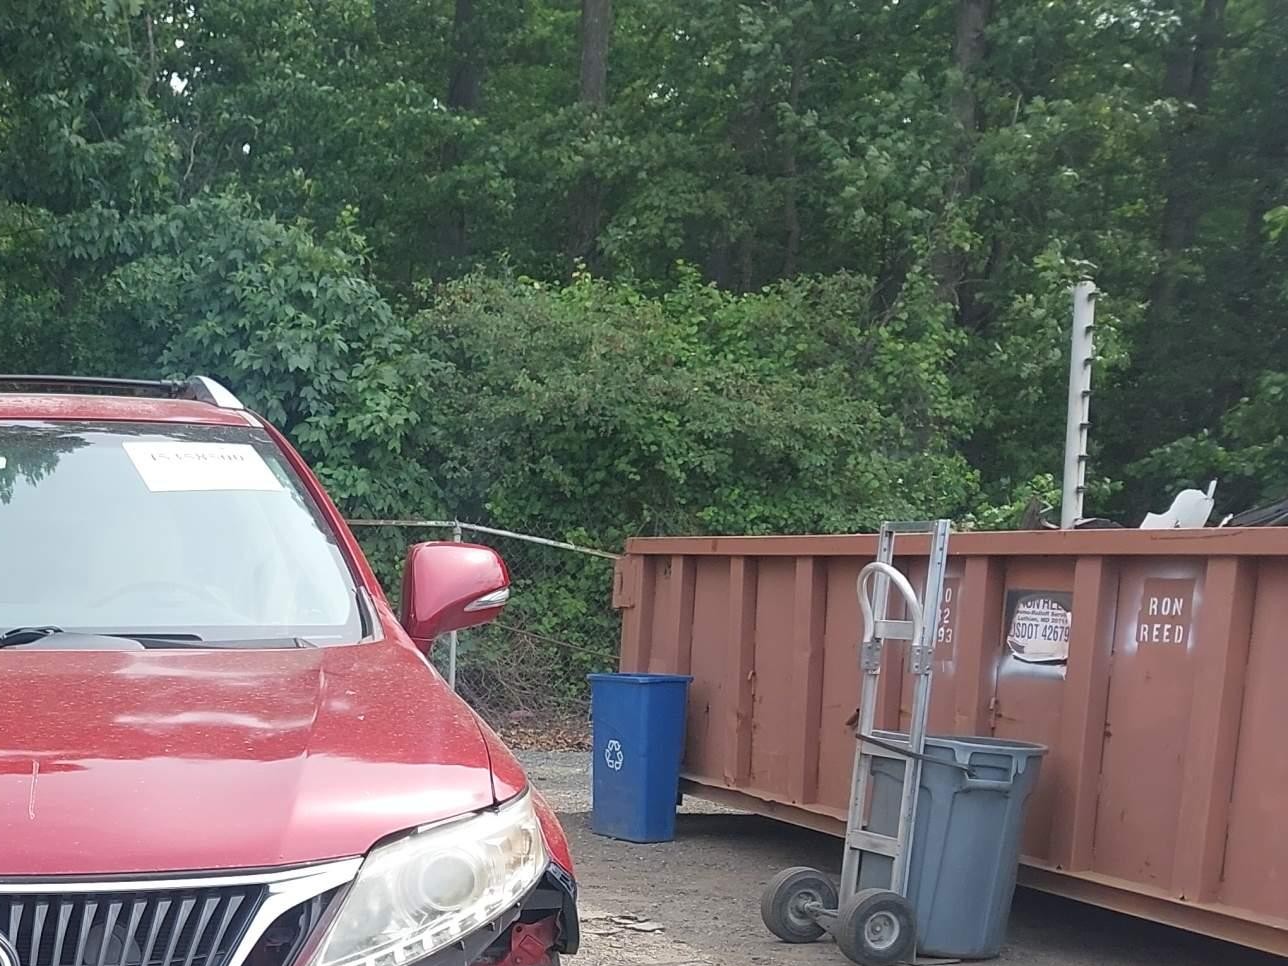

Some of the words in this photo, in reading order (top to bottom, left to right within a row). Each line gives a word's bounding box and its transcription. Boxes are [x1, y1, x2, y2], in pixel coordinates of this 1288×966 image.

[1148, 597, 1183, 616] RON
[1042, 624, 1069, 642] 42679
[1139, 624, 1183, 643] REED
